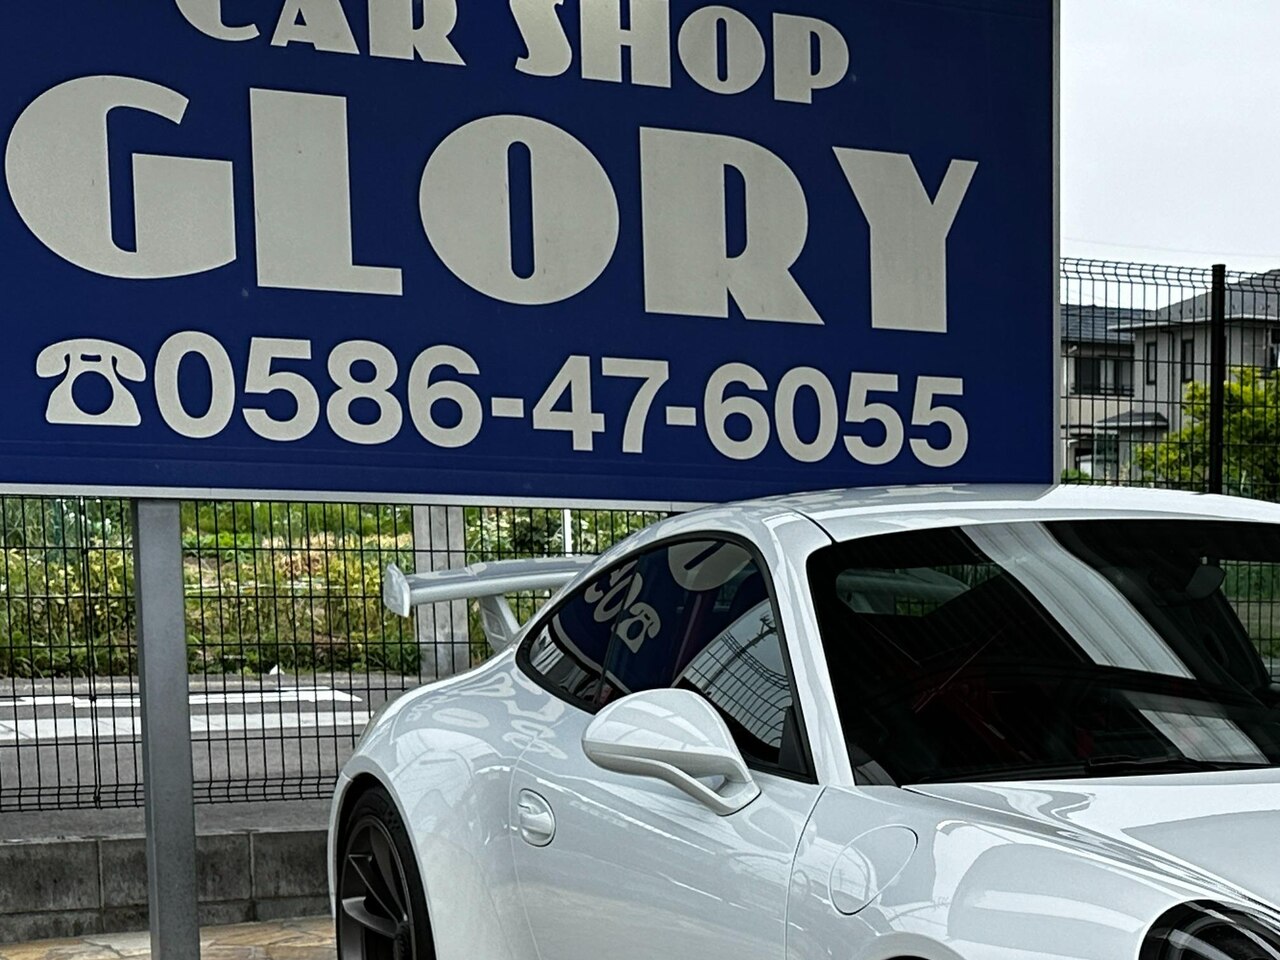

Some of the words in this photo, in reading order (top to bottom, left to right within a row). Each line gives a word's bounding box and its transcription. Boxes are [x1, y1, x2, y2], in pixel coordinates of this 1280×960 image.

[508, 0, 850, 104] SHOP
[4, 74, 979, 333] GLORY
[154, 330, 969, 468] 0586-47-6055
